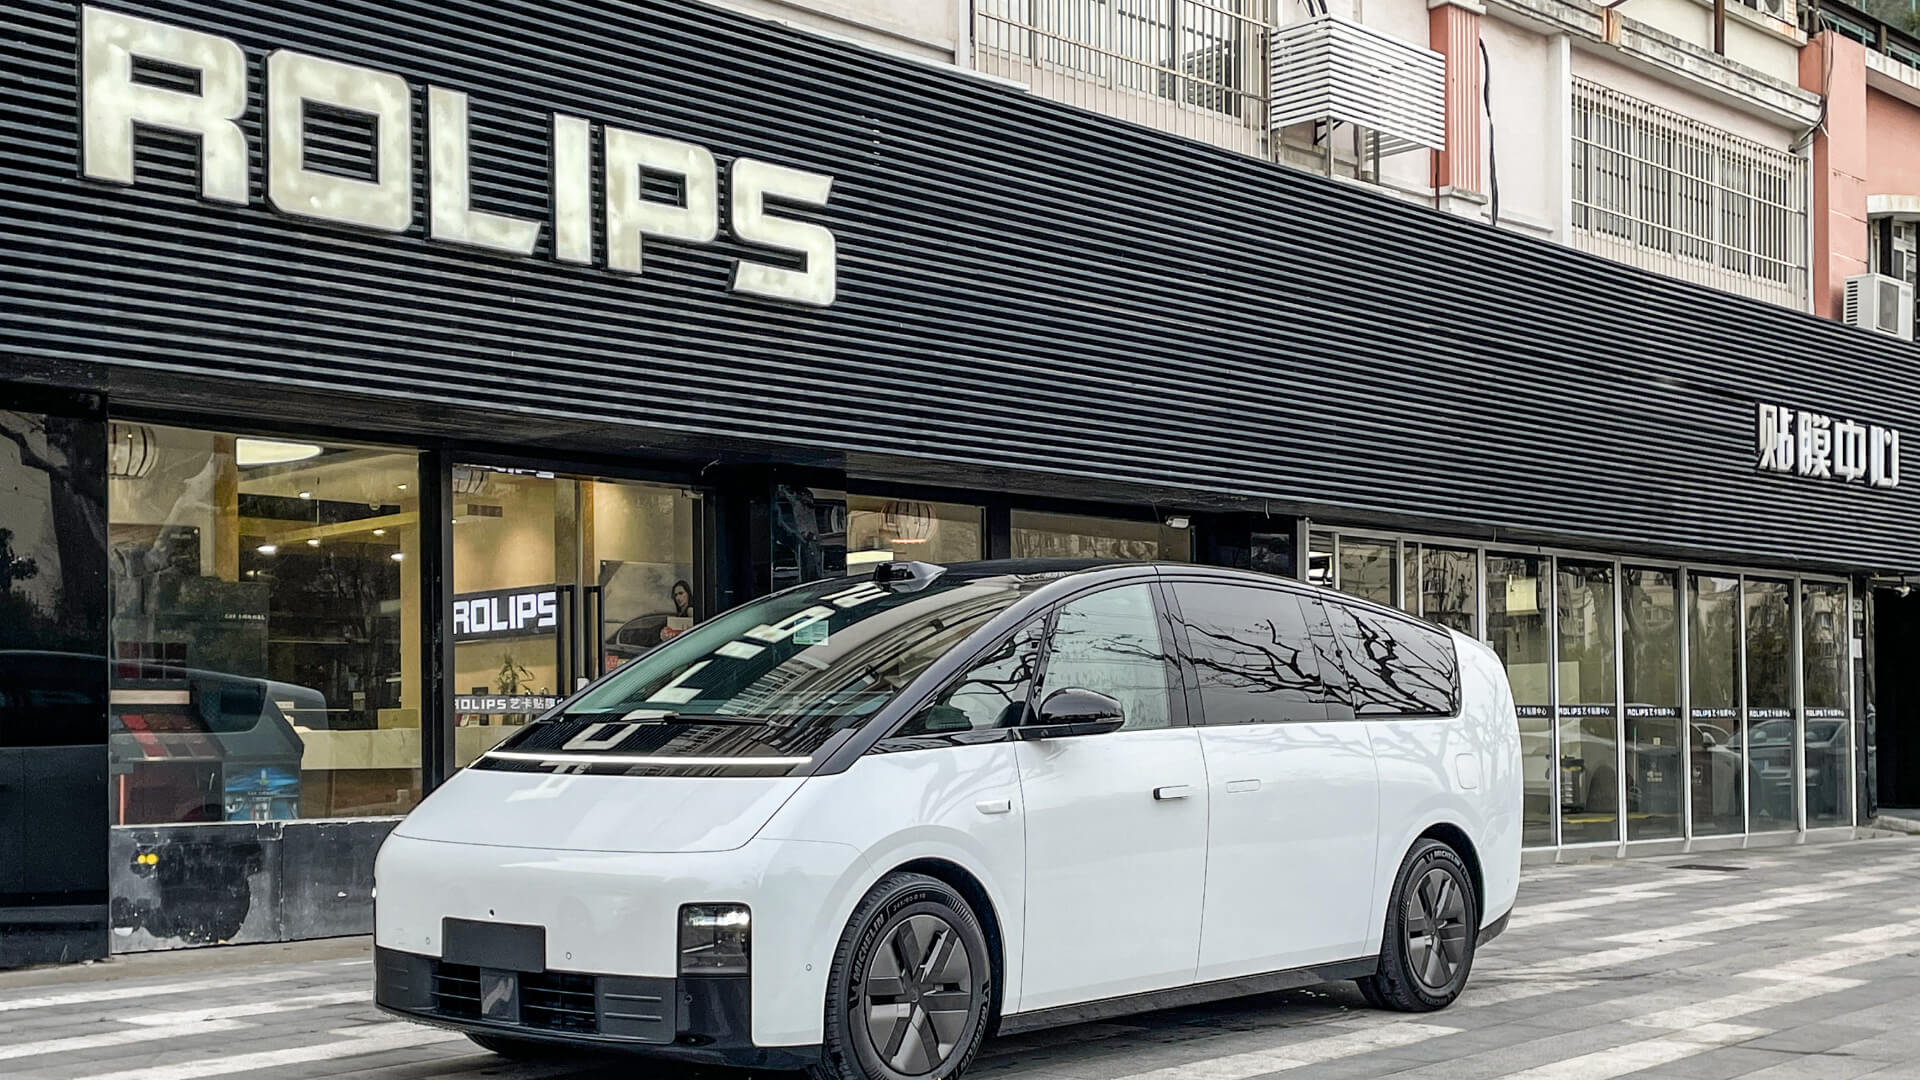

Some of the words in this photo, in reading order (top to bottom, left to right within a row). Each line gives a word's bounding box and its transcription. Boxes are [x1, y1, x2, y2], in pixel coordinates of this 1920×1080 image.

[80, 3, 838, 308] ROLIPS
[1757, 402, 1900, 488] 贴膜中心
[453, 591, 557, 635] ROLIPS
[853, 913, 885, 983] MICHELIN
